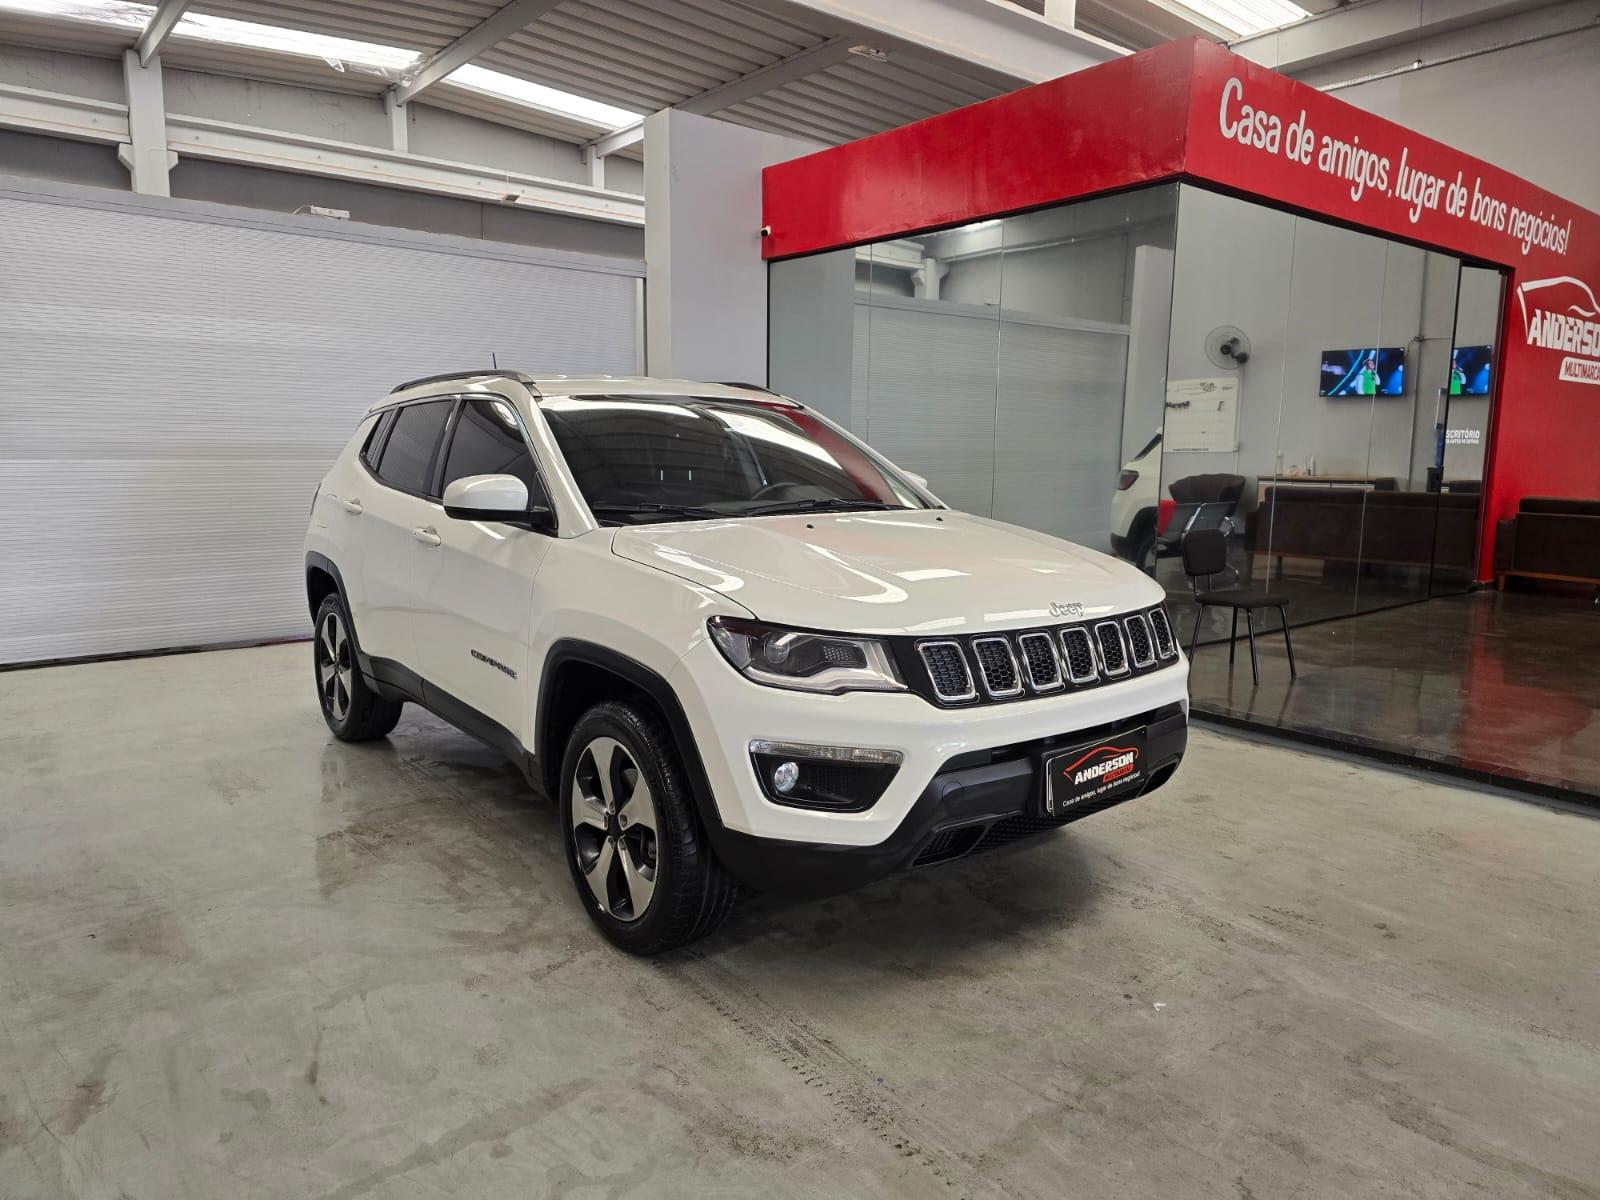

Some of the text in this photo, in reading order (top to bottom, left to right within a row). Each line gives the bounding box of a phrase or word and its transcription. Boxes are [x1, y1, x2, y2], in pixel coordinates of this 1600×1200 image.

[1219, 77, 1571, 255] Casa de amigos, lugar de bons negócios!
[1445, 427, 1480, 438] SCRITÓRIO
[1049, 602, 1083, 617] Jeep
[1074, 751, 1134, 785] ANDERSON
